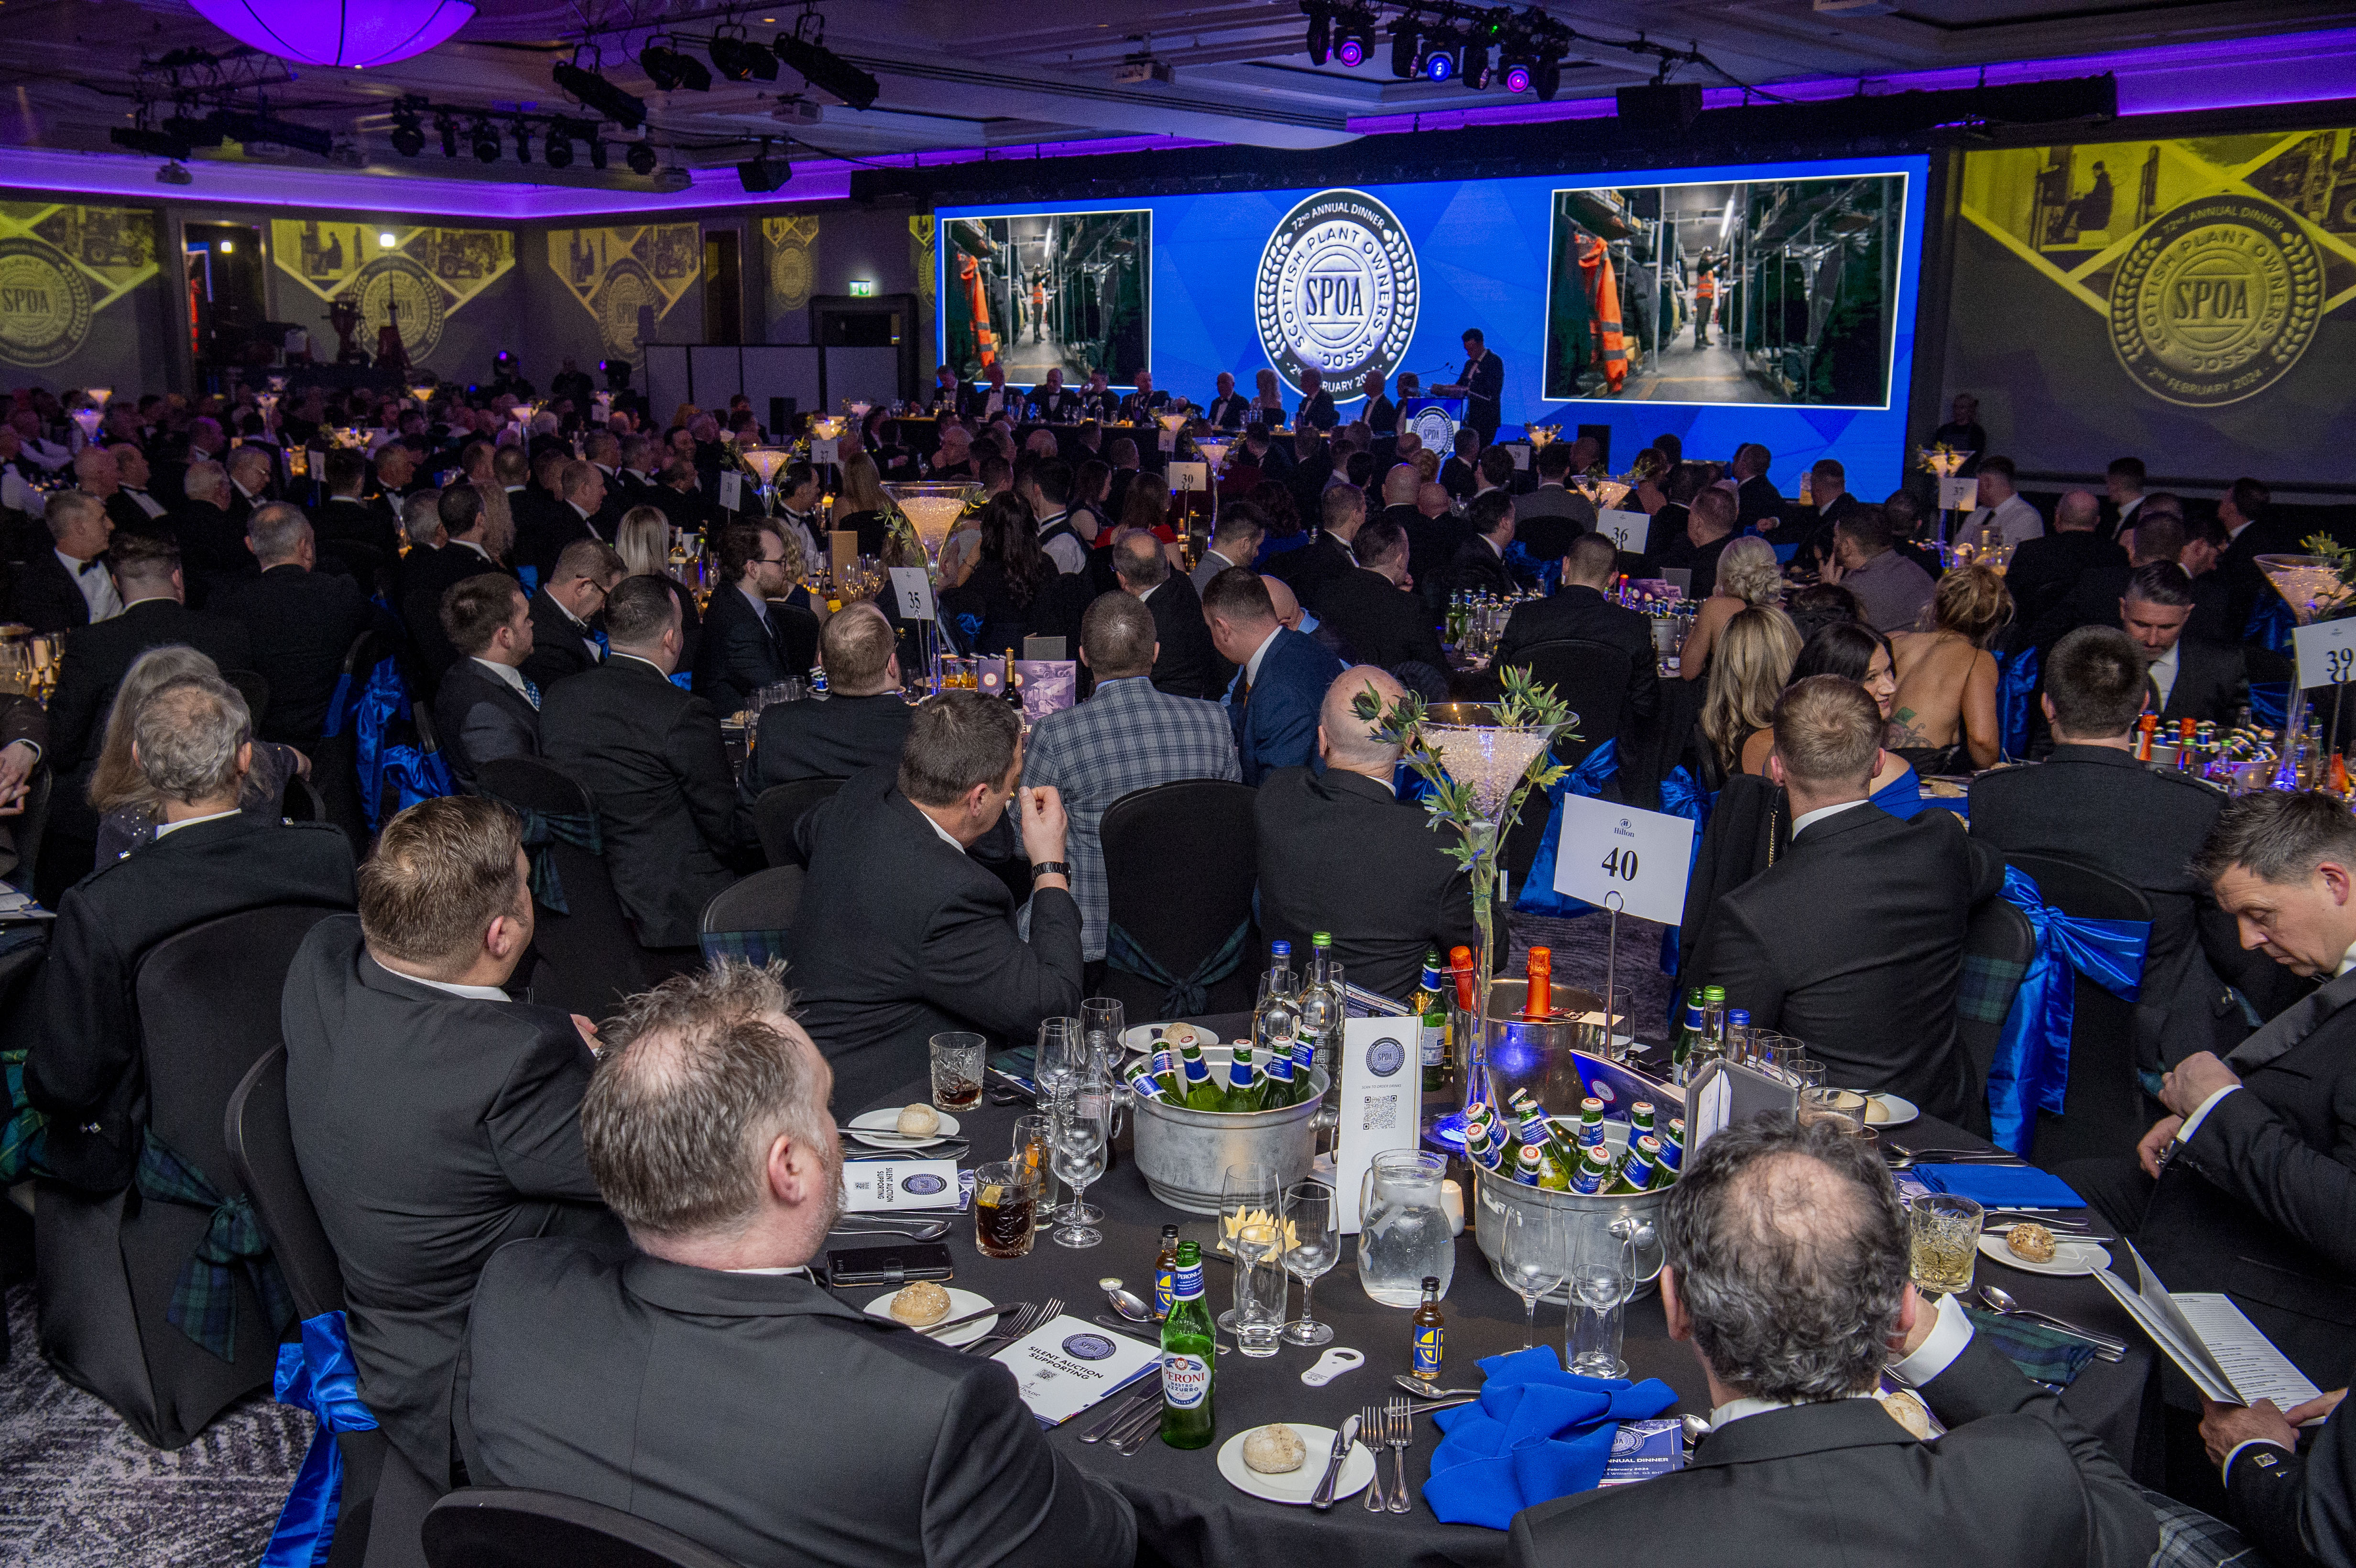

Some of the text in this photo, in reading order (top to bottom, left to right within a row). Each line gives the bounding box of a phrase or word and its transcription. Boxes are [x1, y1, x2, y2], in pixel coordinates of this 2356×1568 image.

[1312, 202, 1349, 218] ANNUAL
[1351, 204, 1385, 229] DINNER
[2189, 206, 2237, 222] ANNUAL
[2239, 207, 2284, 231] DINNER
[1282, 251, 1305, 348] SCOTTISH
[1307, 227, 1361, 250] PLANT
[1364, 241, 1390, 332] OWNERS
[1307, 277, 1364, 317] SPOA
[2144, 254, 2174, 352] SCOTTISH
[2180, 230, 2251, 251] PLANT
[2254, 244, 2287, 336] OWNERS
[2174, 280, 2248, 319] SPOA
[2, 288, 50, 313] SPOA
[1321, 379, 1353, 392] RUARY
[2167, 378, 2230, 396] FEBRUARY
[1611, 527, 1628, 541] 36
[907, 591, 921, 609] 35
[2326, 647, 2355, 672] 39
[1614, 827, 1635, 838] Hilton
[1601, 847, 1639, 882] 40
[1378, 1053, 1392, 1061] SPOA
[1178, 1271, 1197, 1280] PERONI
[1079, 1341, 1099, 1352] SPOA
[1028, 1346, 1104, 1379] SILENT AUCTION
[1028, 1352, 1091, 1380] SUPPORTING
[1164, 1367, 1205, 1383] PERONI
[1167, 1384, 1199, 1392] AZZURRO
